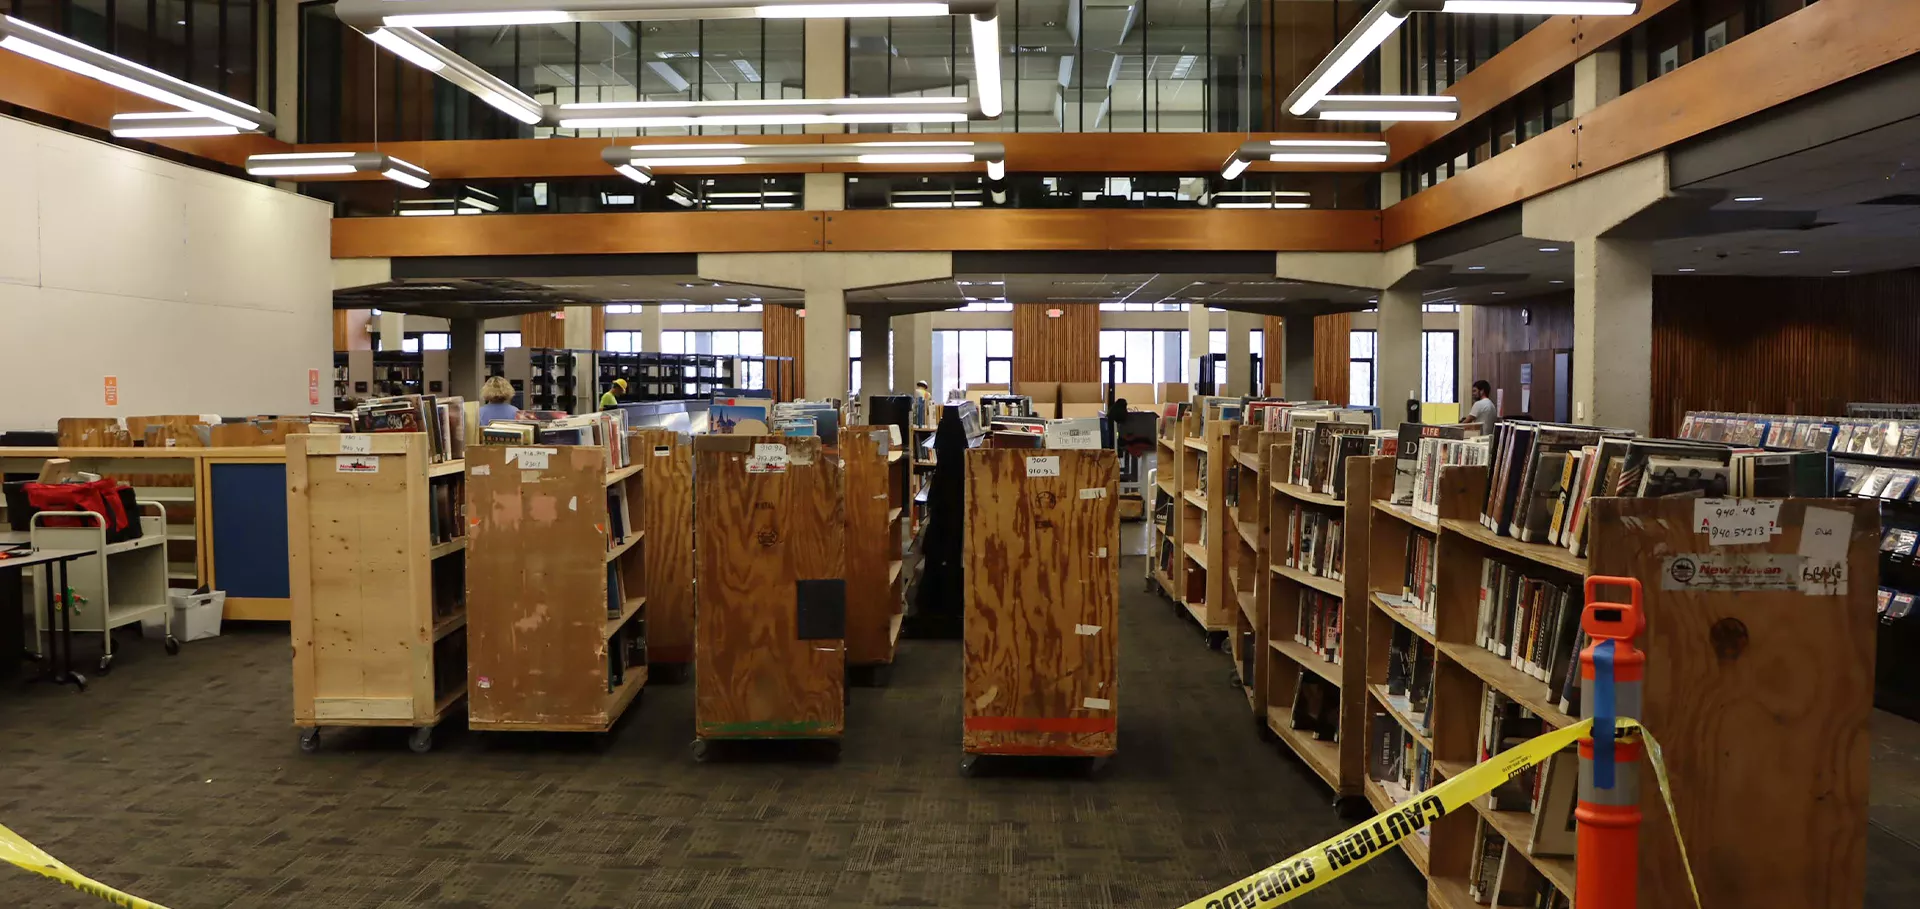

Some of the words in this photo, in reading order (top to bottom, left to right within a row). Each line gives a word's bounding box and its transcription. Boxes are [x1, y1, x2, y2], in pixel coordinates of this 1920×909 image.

[1320, 427, 1365, 438] ENGLISH
[1422, 427, 1440, 437] LIFE
[1699, 564, 1733, 575] New
[1509, 764, 1529, 778] ULINE
[1323, 794, 1445, 872] CAUTION
